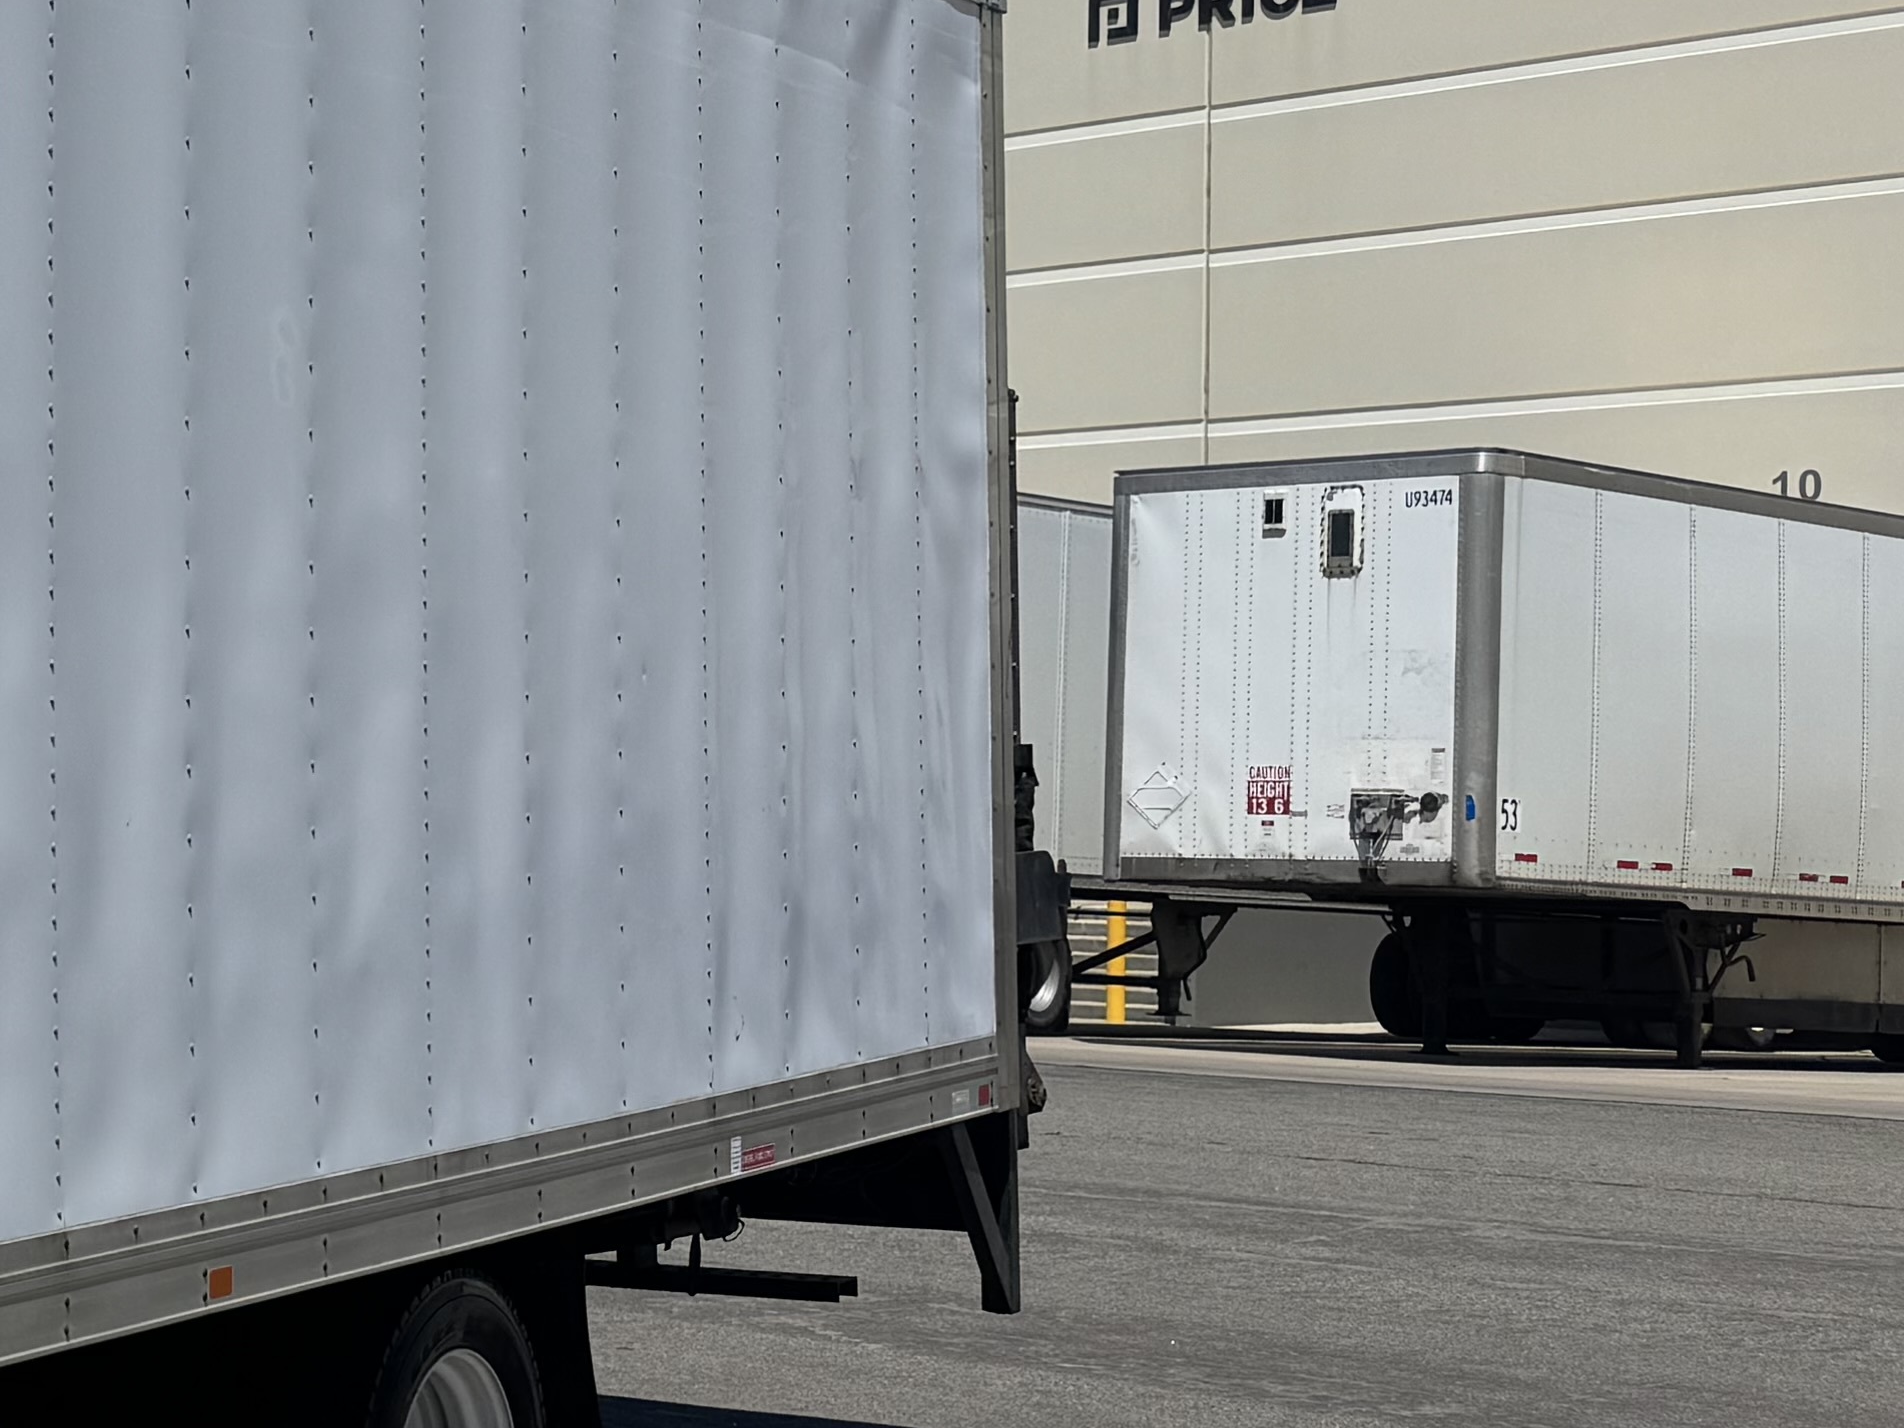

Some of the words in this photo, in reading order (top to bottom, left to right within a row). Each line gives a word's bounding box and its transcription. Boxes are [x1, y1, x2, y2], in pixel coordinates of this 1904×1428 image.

[1772, 468, 1822, 500] 10
[1404, 488, 1453, 509] U93474
[1249, 765, 1291, 780] CAUTION
[1249, 781, 1289, 800] HEIGHT
